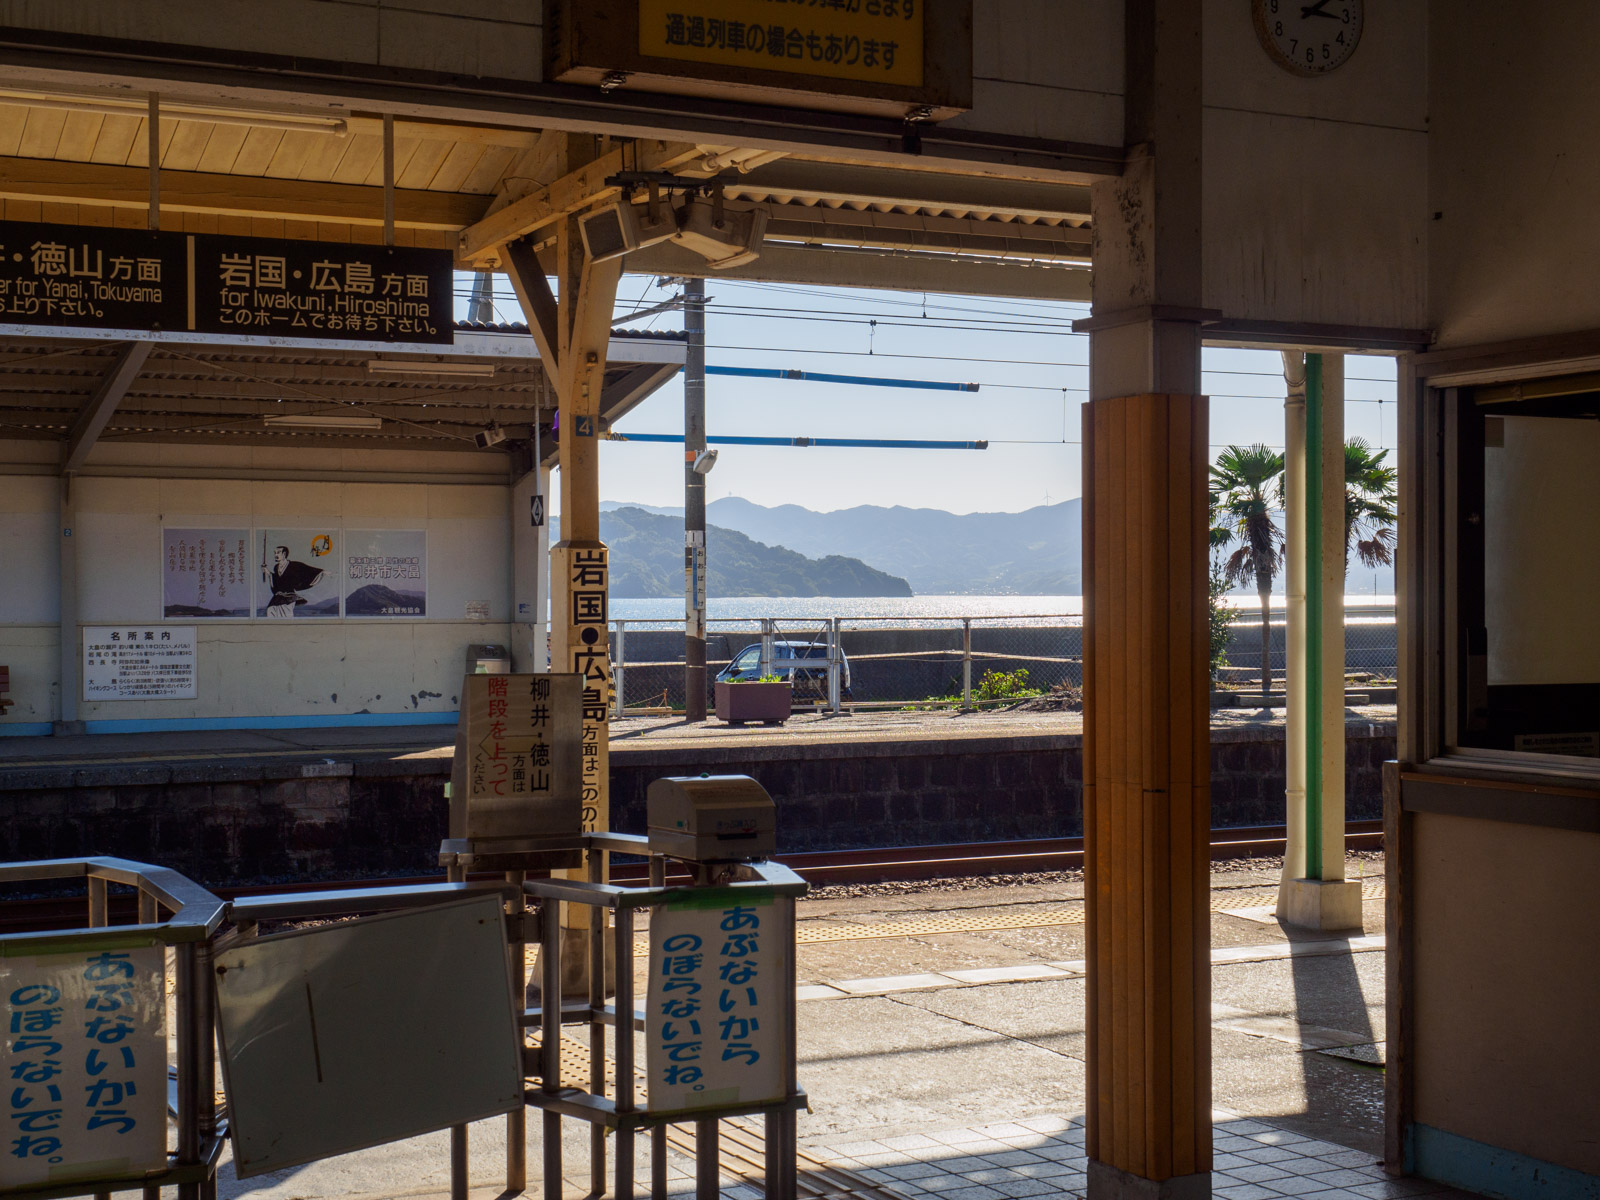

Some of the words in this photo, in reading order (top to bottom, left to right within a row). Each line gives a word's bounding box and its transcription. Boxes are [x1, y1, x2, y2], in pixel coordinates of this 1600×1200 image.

[1271, 0, 1278, 13] 9
[1341, 9, 1350, 24] 3
[1275, 21, 1283, 36] 8
[1336, 31, 1345, 45] 4
[665, 13, 899, 70] 通過列車の場合もあります
[1290, 39, 1298, 54] 7
[1306, 48, 1314, 62] 6
[1322, 44, 1330, 59] 5
[16, 277, 38, 295] for
[220, 287, 249, 307] for
[219, 308, 437, 335] このホームでお待ち下さい。
[578, 420, 590, 435] 4
[110, 631, 171, 641] 名所案内
[488, 677, 509, 796] 階段を上って
[473, 752, 486, 794] ください
[512, 755, 525, 793] 方面は
[718, 906, 760, 1066] あぶないから
[661, 933, 705, 1092] のぼらないでね。
[83, 952, 137, 1135] あぶないから
[9, 984, 64, 1164] のぼらないでね。
